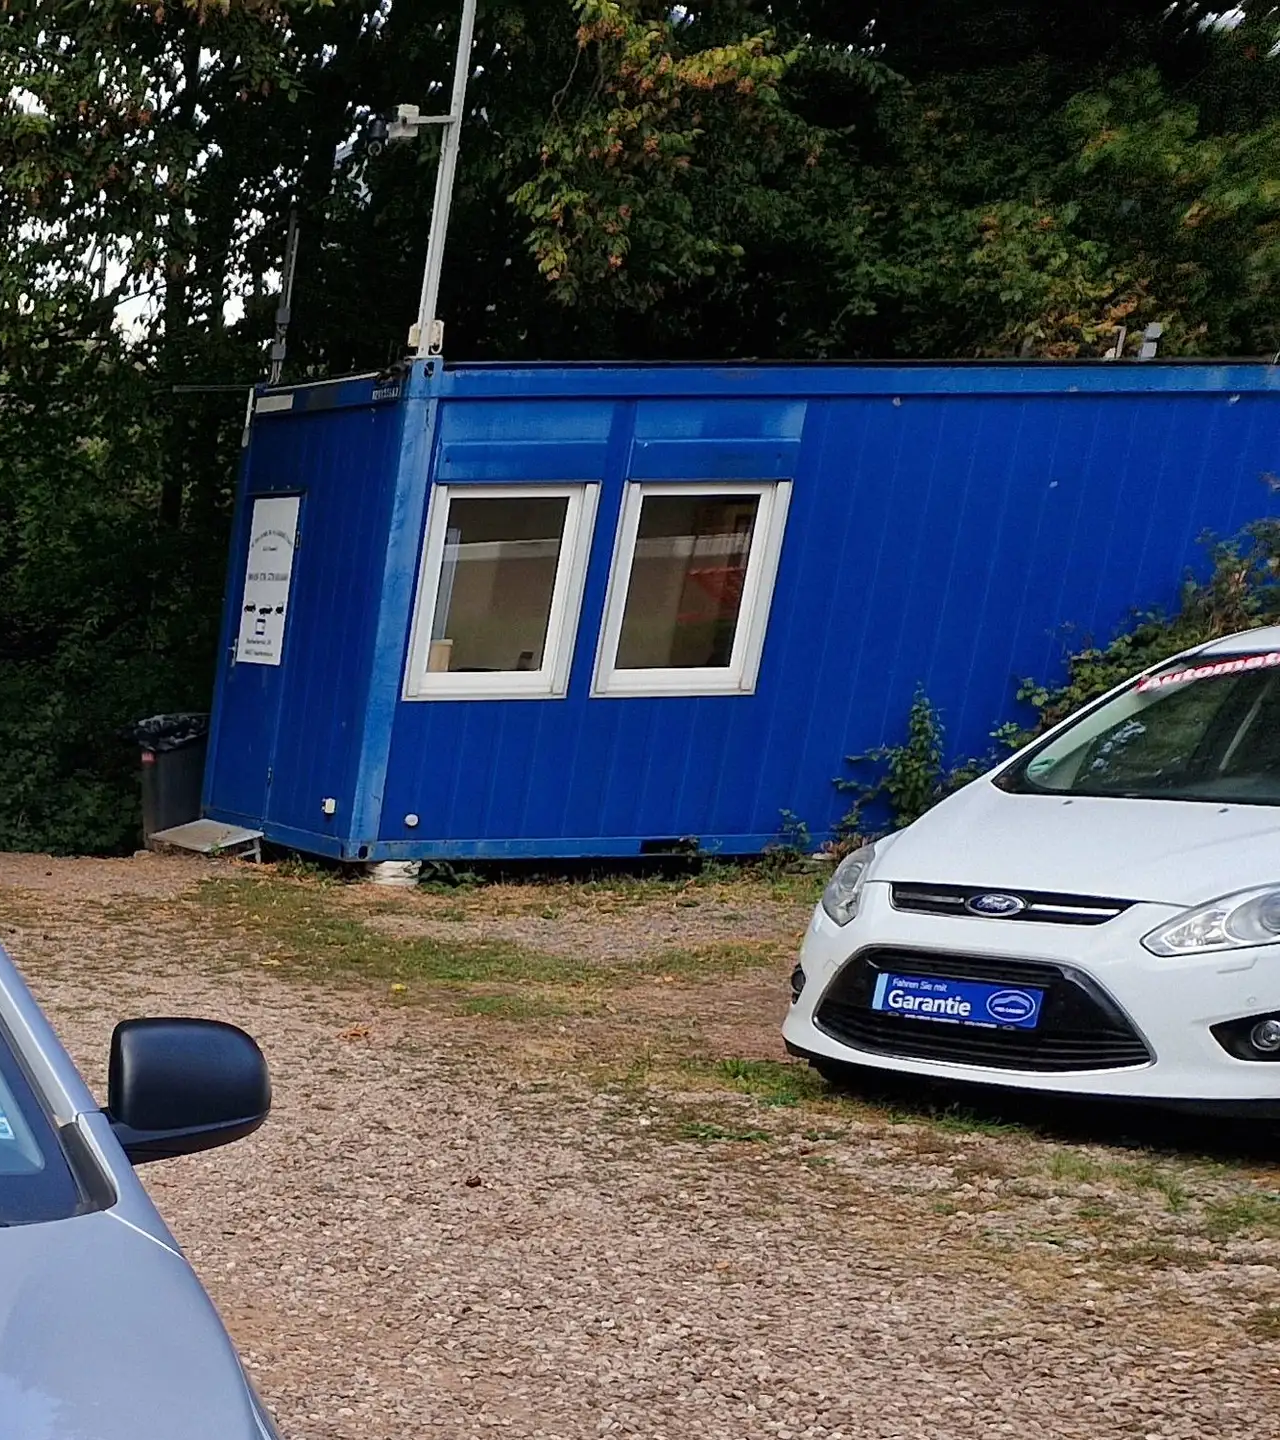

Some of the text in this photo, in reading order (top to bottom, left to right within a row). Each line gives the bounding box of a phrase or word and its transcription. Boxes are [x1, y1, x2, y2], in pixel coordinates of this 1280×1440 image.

[1137, 652, 1280, 692] Automat
[892, 978, 947, 992] Fahren Sie mit
[888, 990, 971, 1016] Garantie
